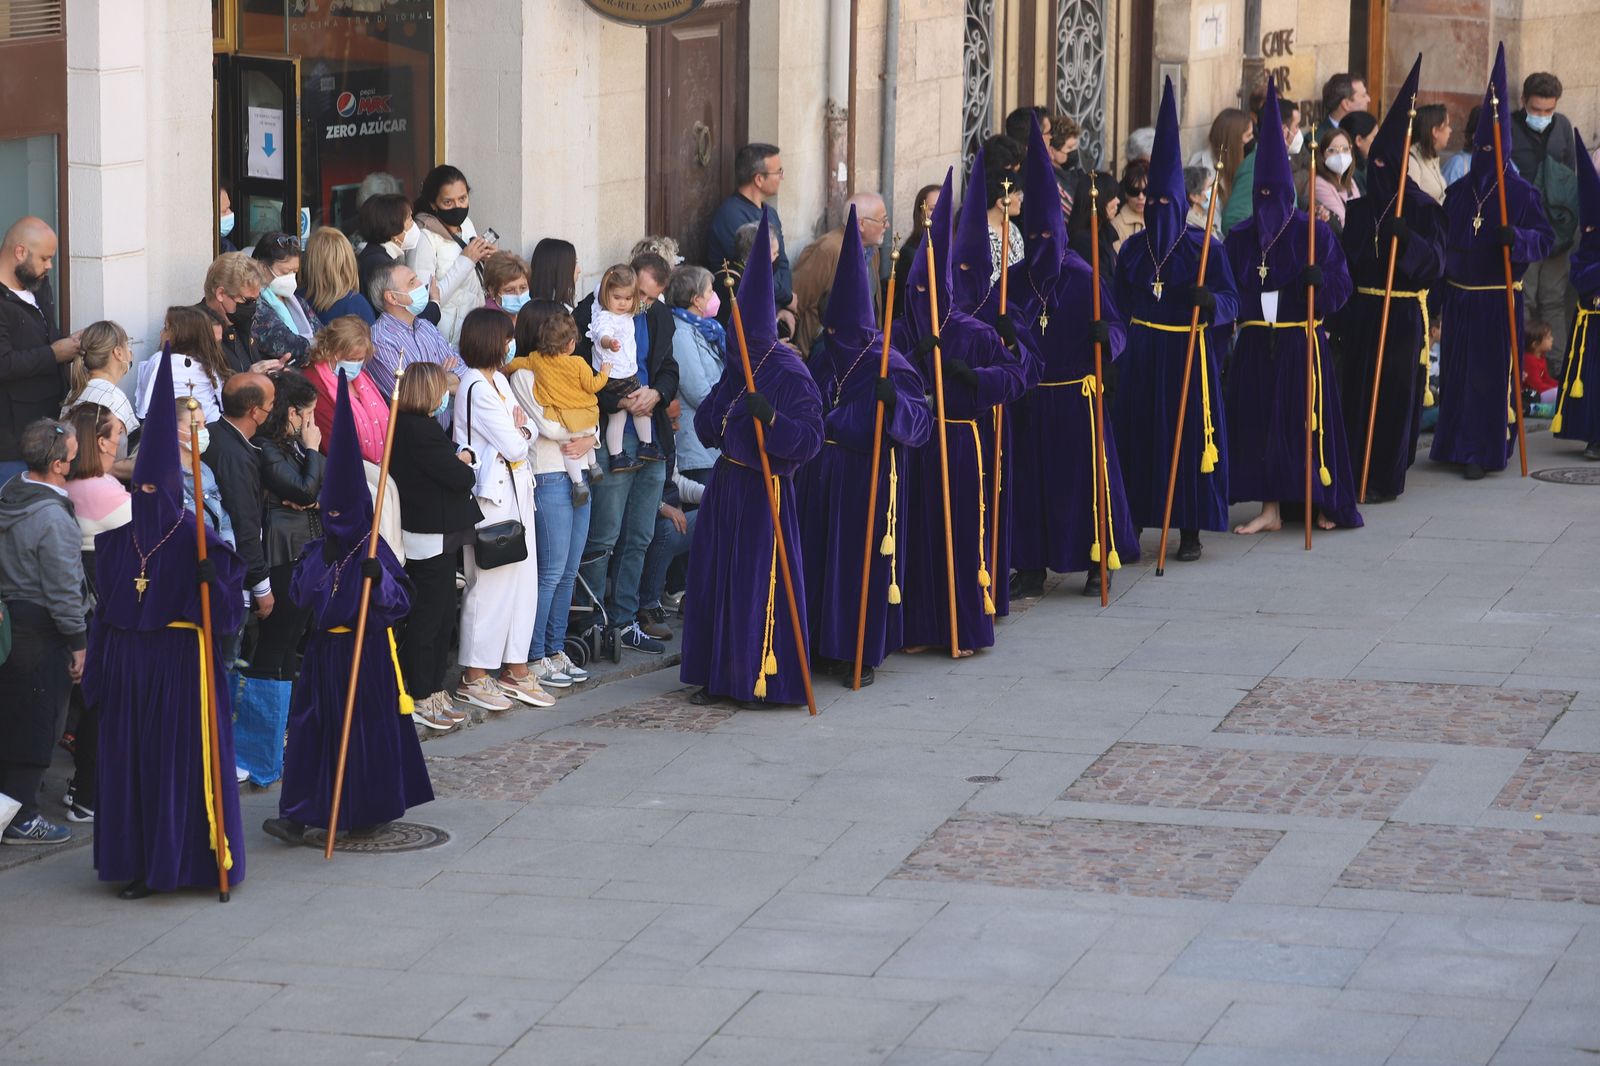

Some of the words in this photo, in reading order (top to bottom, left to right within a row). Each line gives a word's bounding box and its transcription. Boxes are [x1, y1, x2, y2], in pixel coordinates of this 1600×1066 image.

[643, 0, 688, 12] ZAMOR
[360, 88, 376, 96] pepsi
[357, 94, 392, 115] MAX
[326, 123, 357, 140] ZERO
[359, 117, 407, 137] AZÚCAR
